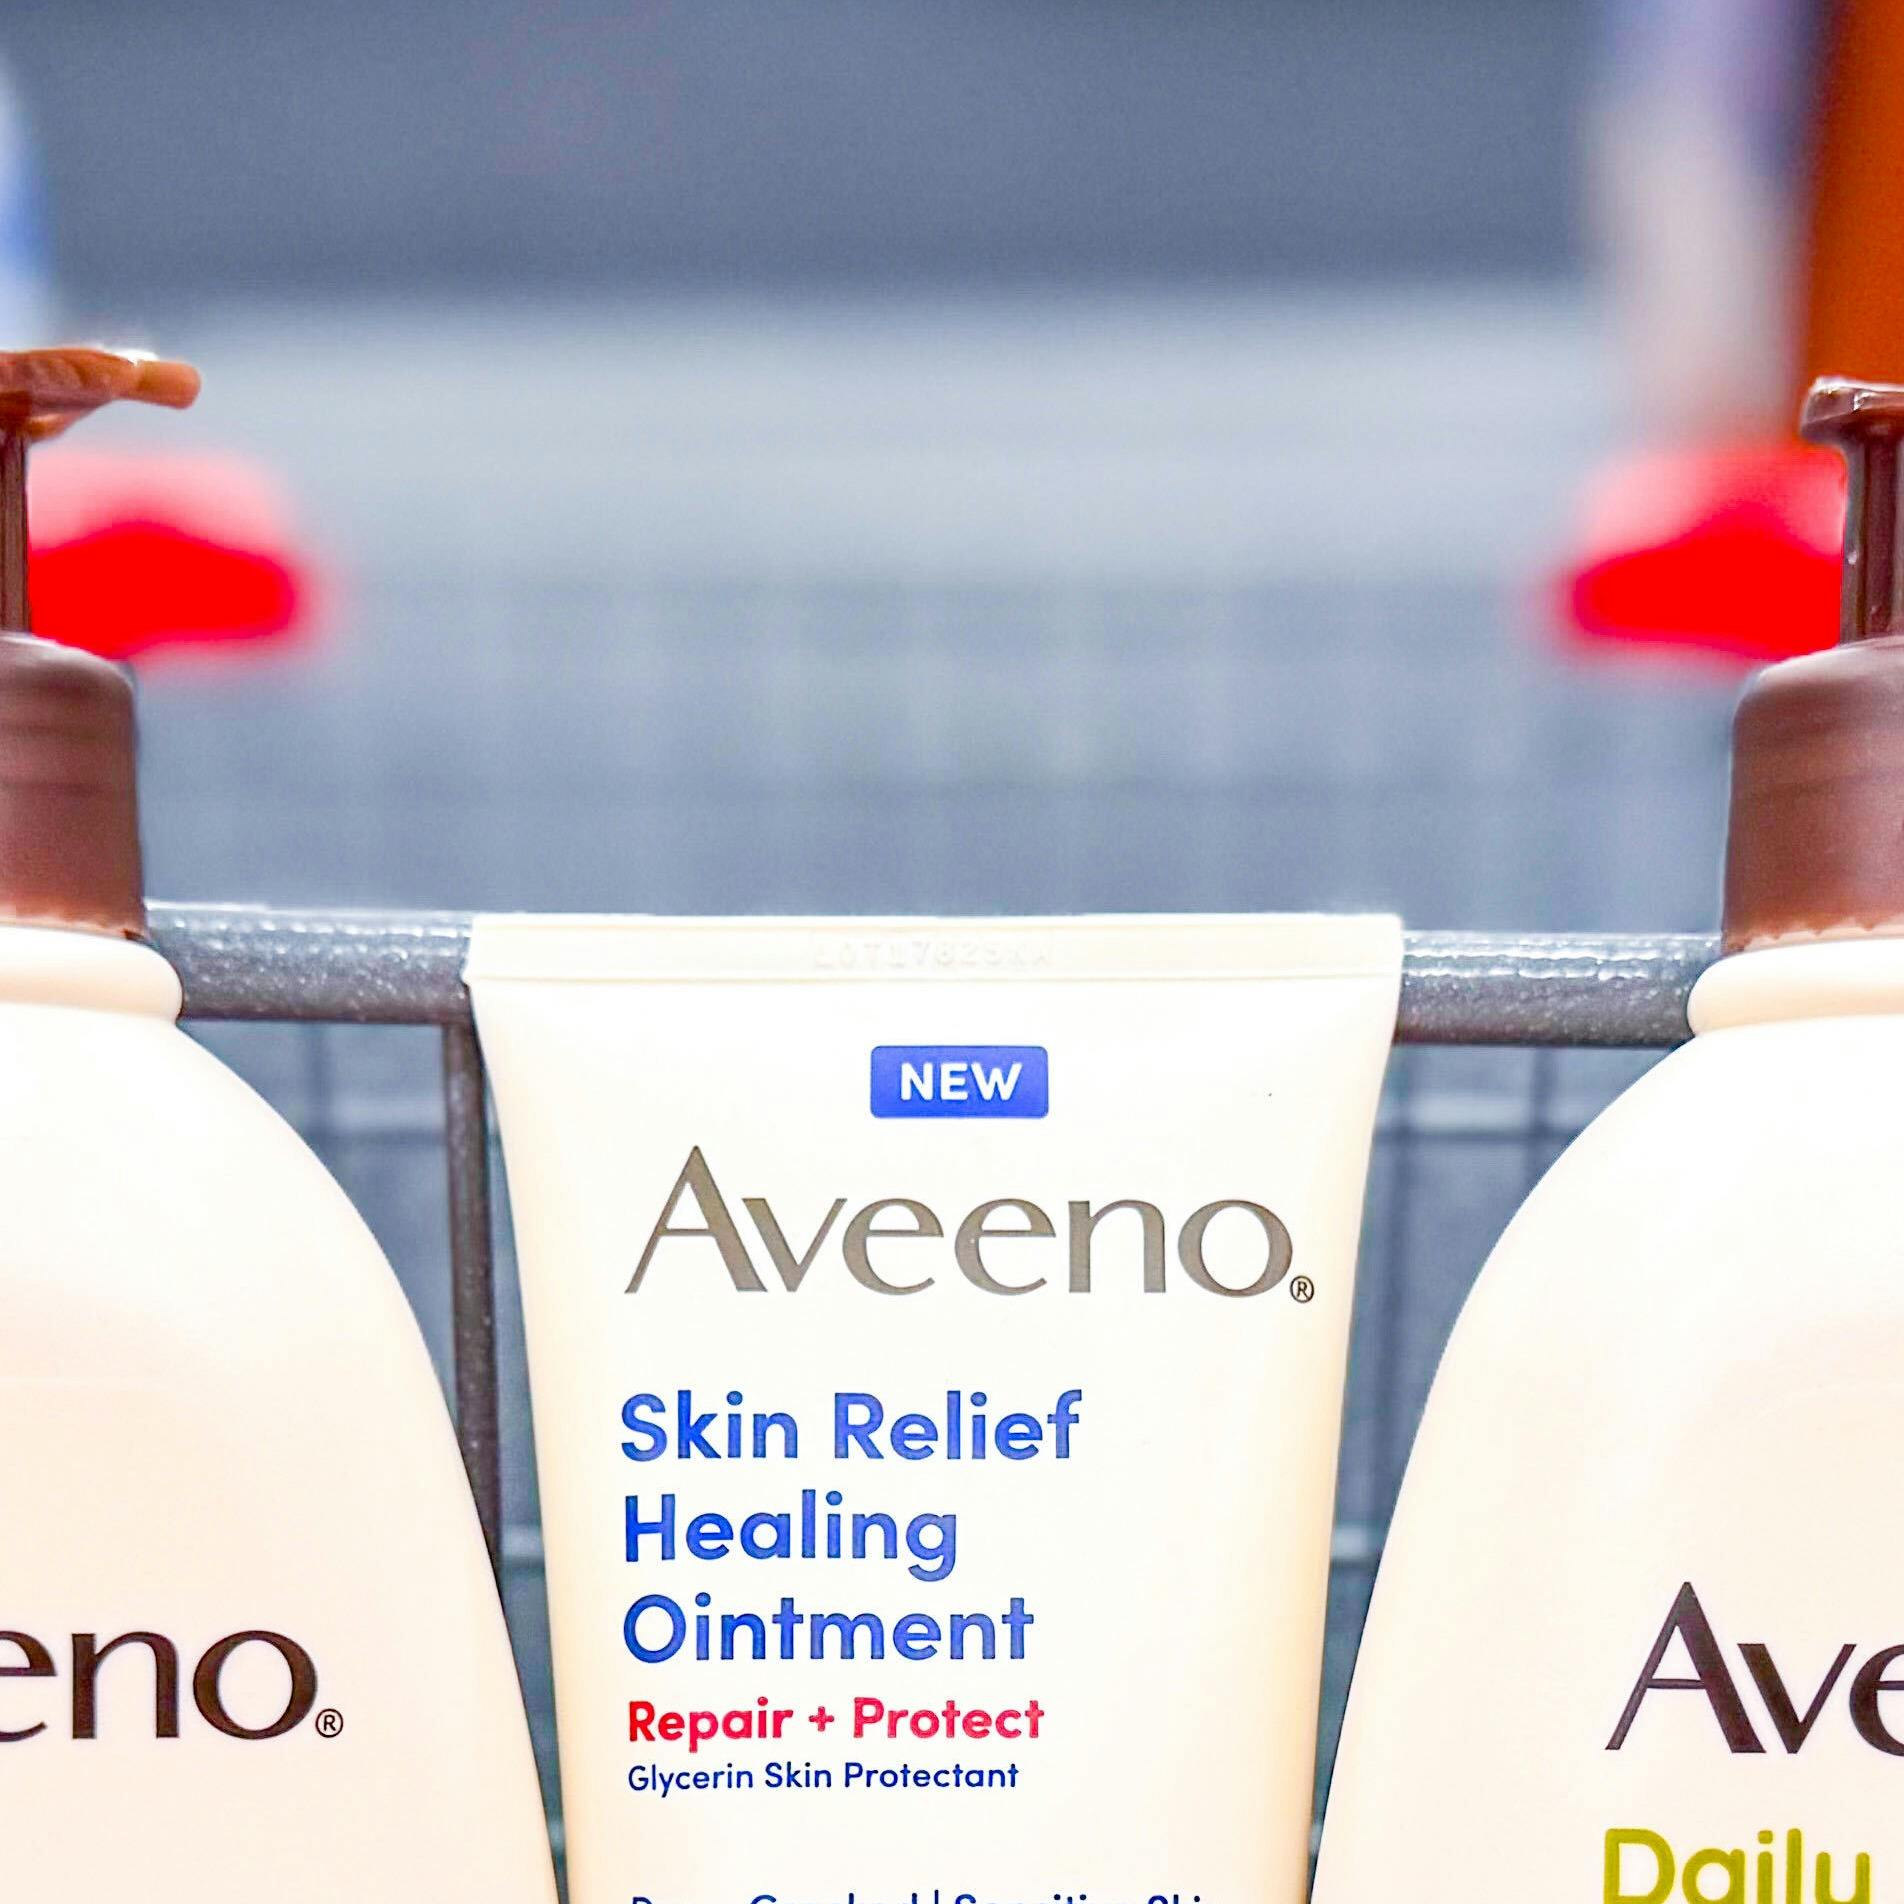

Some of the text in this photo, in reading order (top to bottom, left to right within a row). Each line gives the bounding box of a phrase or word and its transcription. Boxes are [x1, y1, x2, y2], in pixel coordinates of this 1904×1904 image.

[900, 1062, 1022, 1101] NEW
[621, 1389, 1082, 1462] Skin Relief
[625, 1489, 956, 1582] Healing
[624, 1592, 1034, 1663] Ointment
[629, 1696, 1044, 1753] Repair + Protect
[629, 1761, 1019, 1798] Glycerin Skin Protectant
